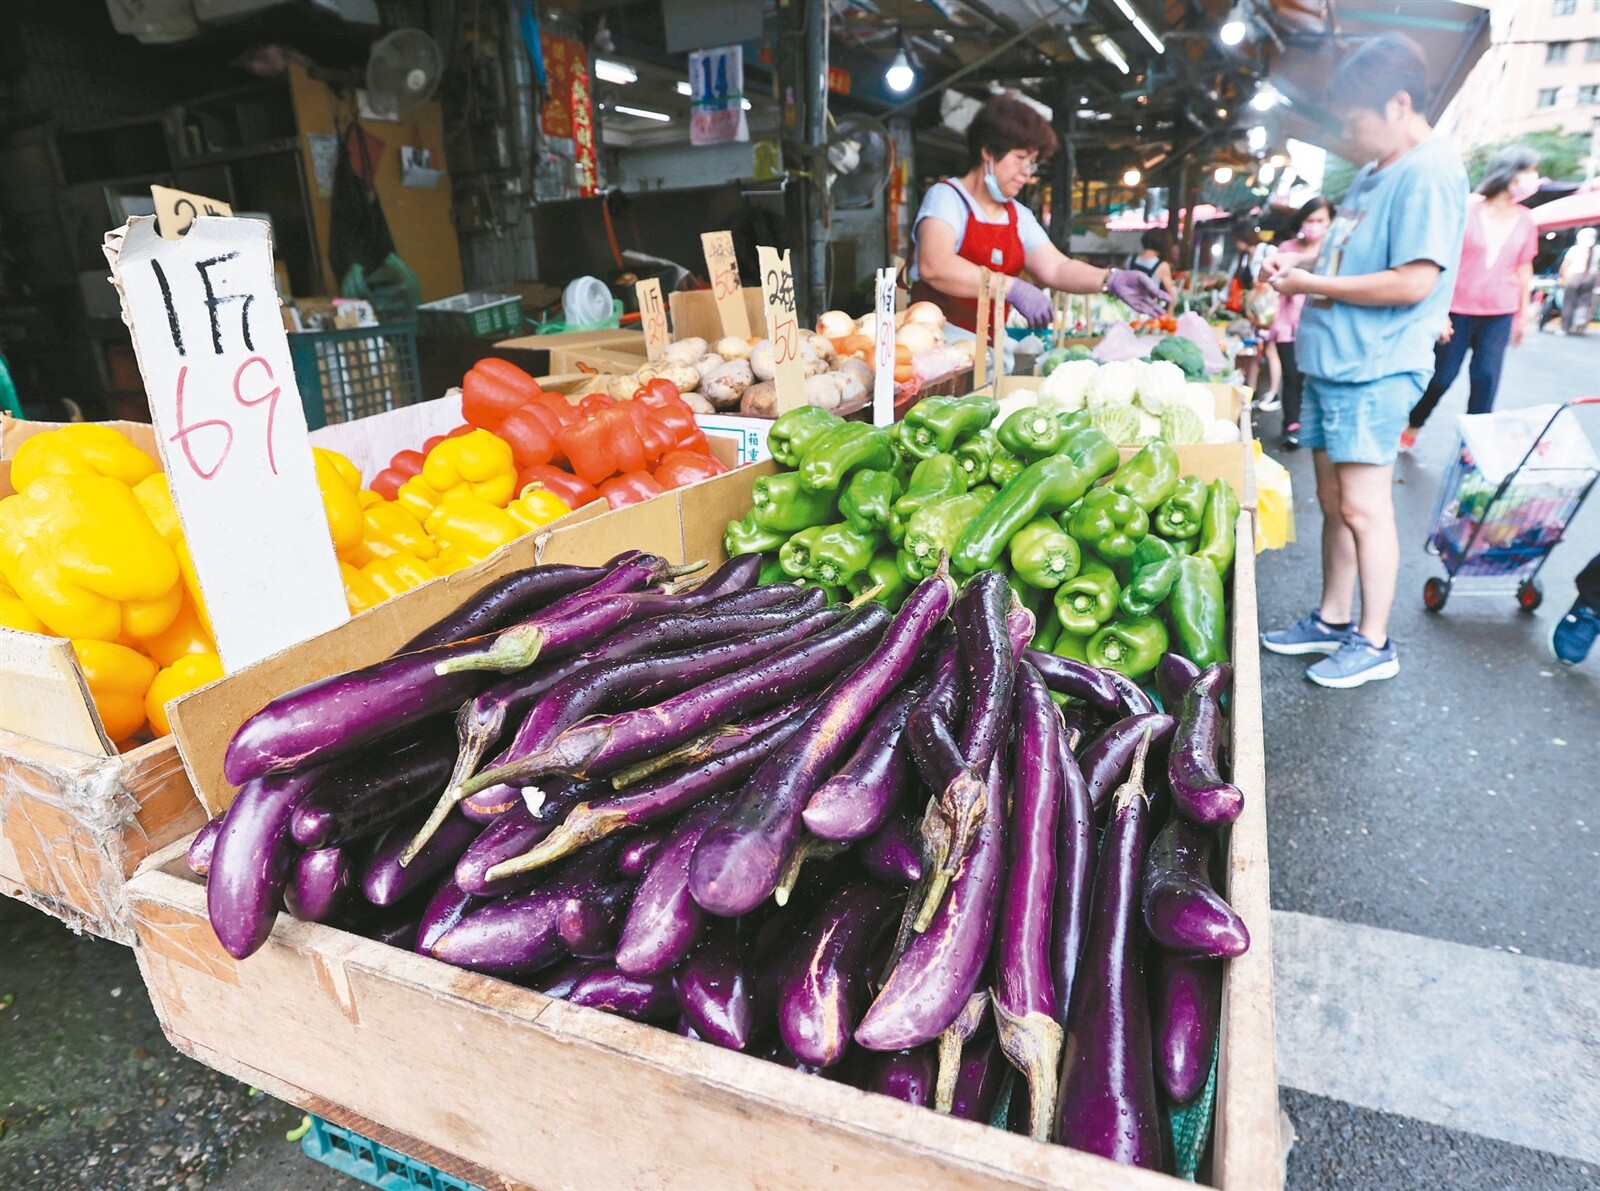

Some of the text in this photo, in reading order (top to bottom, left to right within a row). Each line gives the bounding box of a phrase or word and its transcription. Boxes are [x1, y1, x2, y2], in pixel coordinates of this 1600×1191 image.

[174, 199, 225, 236] 2
[775, 315, 798, 365] 50
[170, 356, 281, 480] 69
[748, 432, 759, 462] 箱重
